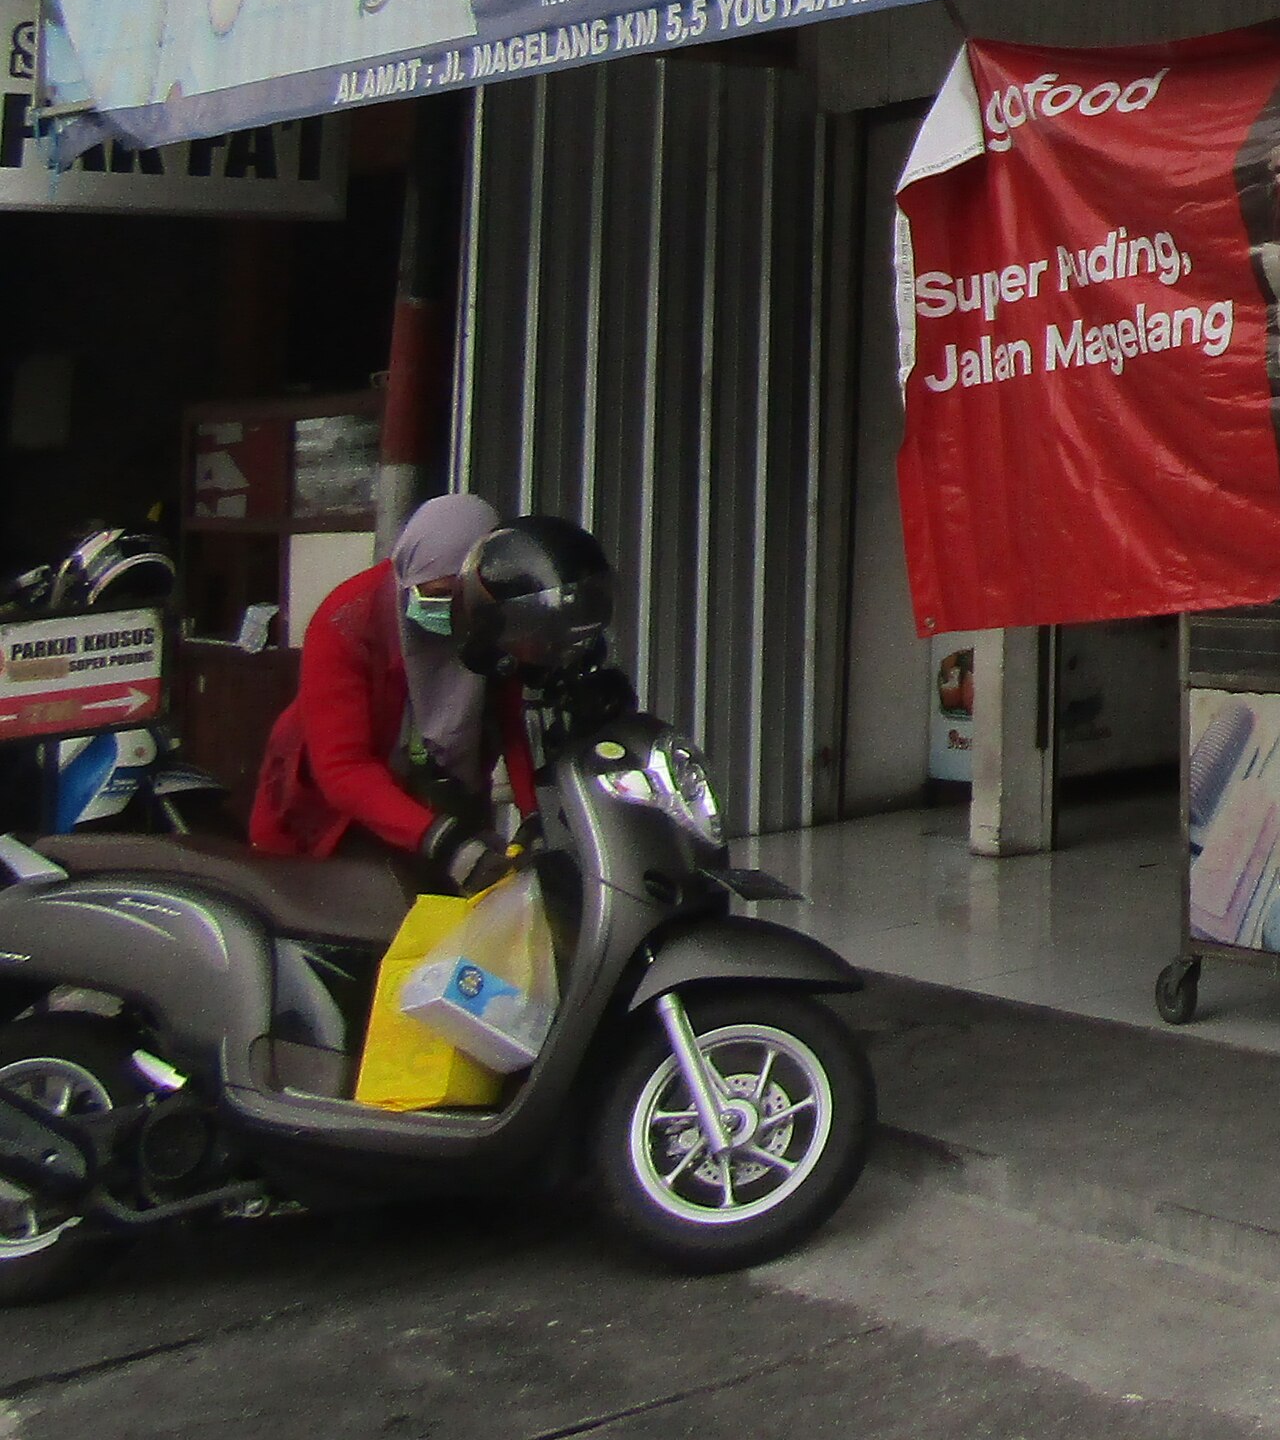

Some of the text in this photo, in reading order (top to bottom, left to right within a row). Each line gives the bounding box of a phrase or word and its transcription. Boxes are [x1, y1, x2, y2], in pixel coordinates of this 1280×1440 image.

[333, 58, 422, 105] ALAMAT
[471, 18, 609, 79] MAGELANG
[615, 8, 659, 51] KM
[985, 67, 1171, 152] gofood
[914, 259, 1049, 321] Super
[923, 299, 1235, 393] Jalan Magelang
[10, 627, 155, 661] PARKIR KHUSUS
[68, 650, 154, 672] SUPER PUDING
